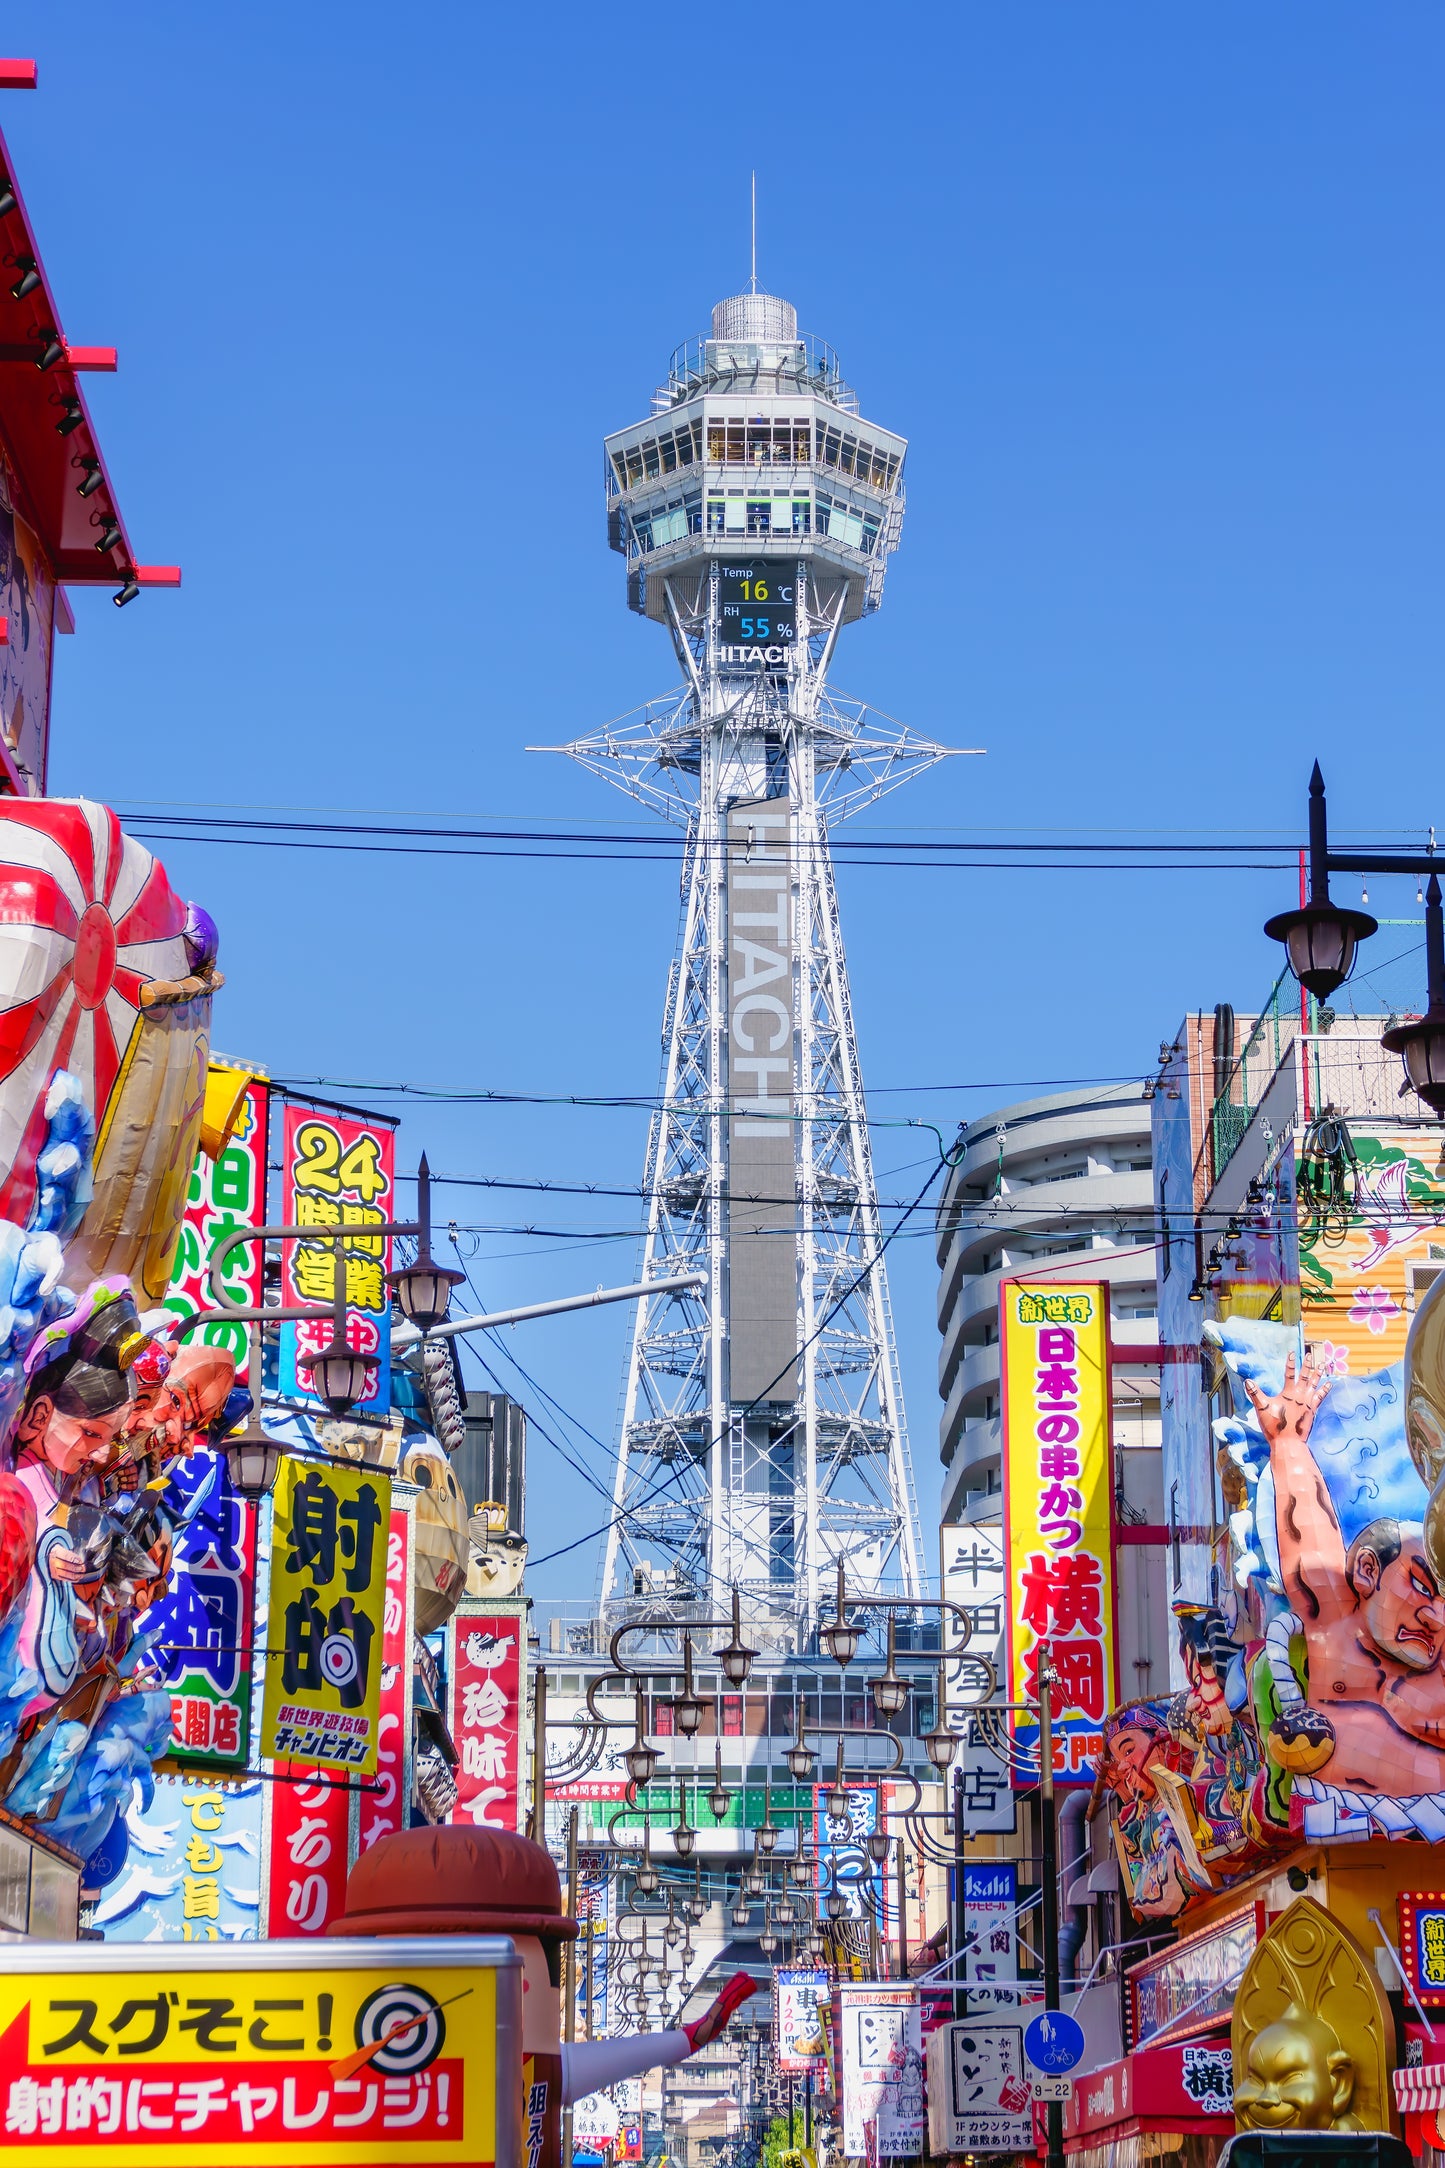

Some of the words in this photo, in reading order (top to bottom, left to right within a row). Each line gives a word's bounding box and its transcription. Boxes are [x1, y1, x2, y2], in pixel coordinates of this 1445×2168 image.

[722, 567, 753, 579] Temp
[740, 580, 769, 601] 16
[724, 606, 739, 616] RH
[741, 618, 770, 638] 55
[777, 624, 793, 638] %
[709, 645, 806, 663] HITACHI
[732, 814, 790, 1138] HITACHI
[297, 1124, 387, 1202] 24
[296, 1193, 384, 1259] 時間
[296, 1248, 385, 1311] 営業
[1019, 1294, 1092, 1324] 新世界
[1036, 1327, 1083, 1551] 日本一の串かつ
[281, 1471, 382, 1708] 射的
[1021, 1553, 1104, 1722] 横綱
[277, 1704, 370, 1736] 新世界遊技場
[275, 1728, 371, 1764] チャンピオン
[963, 1875, 1011, 1898] Asahi
[1426, 1918, 1445, 1981] 新世界
[790, 1973, 815, 1985] Asahi
[43, 1991, 335, 2056] スグそこ!
[1185, 2050, 1232, 2061] 日本一の
[5, 2072, 450, 2135] 射的にチャレンジ!
[955, 2121, 966, 2132] 1F
[969, 2120, 1032, 2134] カウンター席
[955, 2135, 966, 2145] 2F
